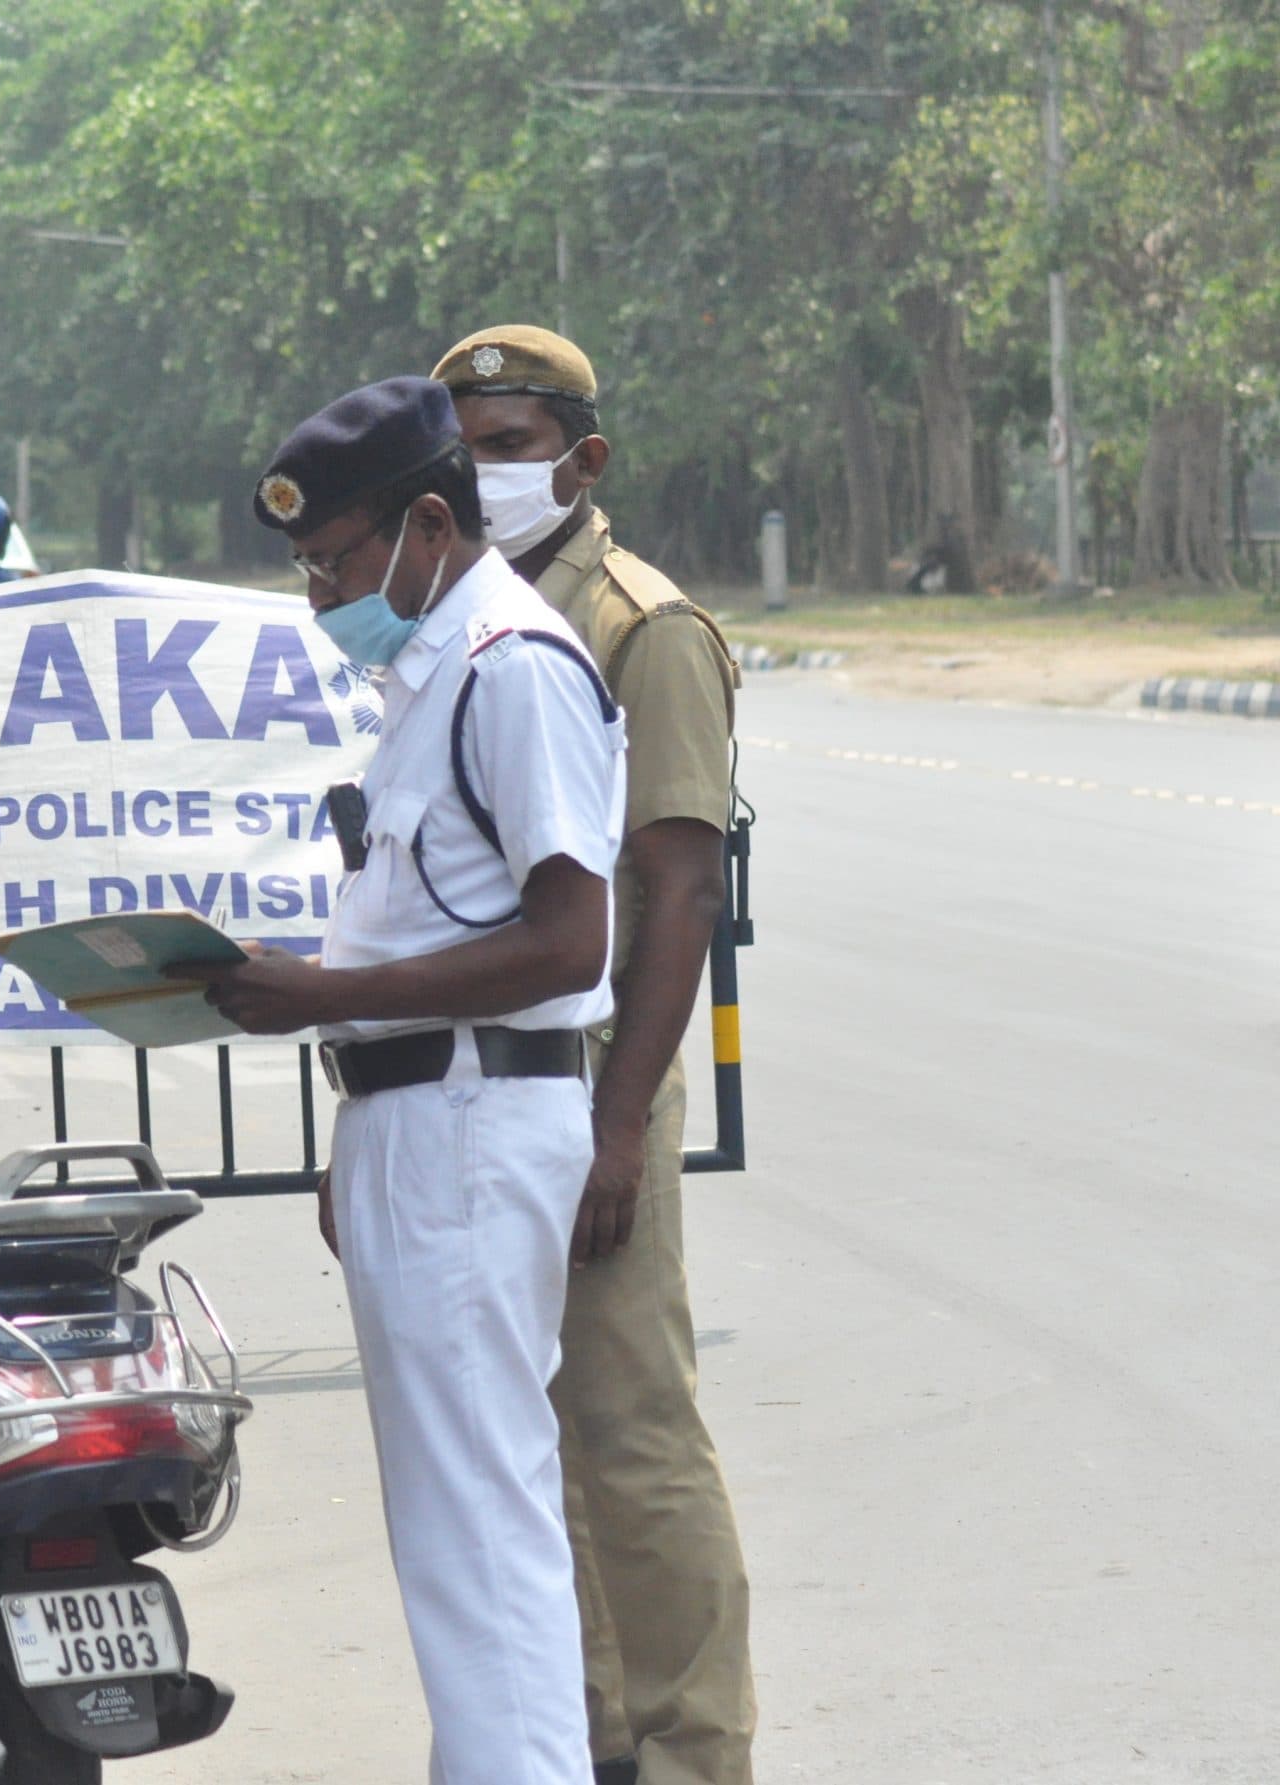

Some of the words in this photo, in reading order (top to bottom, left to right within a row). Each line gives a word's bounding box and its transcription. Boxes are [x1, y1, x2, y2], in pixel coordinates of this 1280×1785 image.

[88, 872, 342, 920] DIVISI
[39, 1328, 122, 1344] HONDA
[39, 1590, 148, 1635] WB01A
[17, 1634, 38, 1646] IND
[57, 1631, 159, 1676] J6983
[99, 1687, 126, 1698] TODI
[97, 1695, 135, 1708] HONDA
